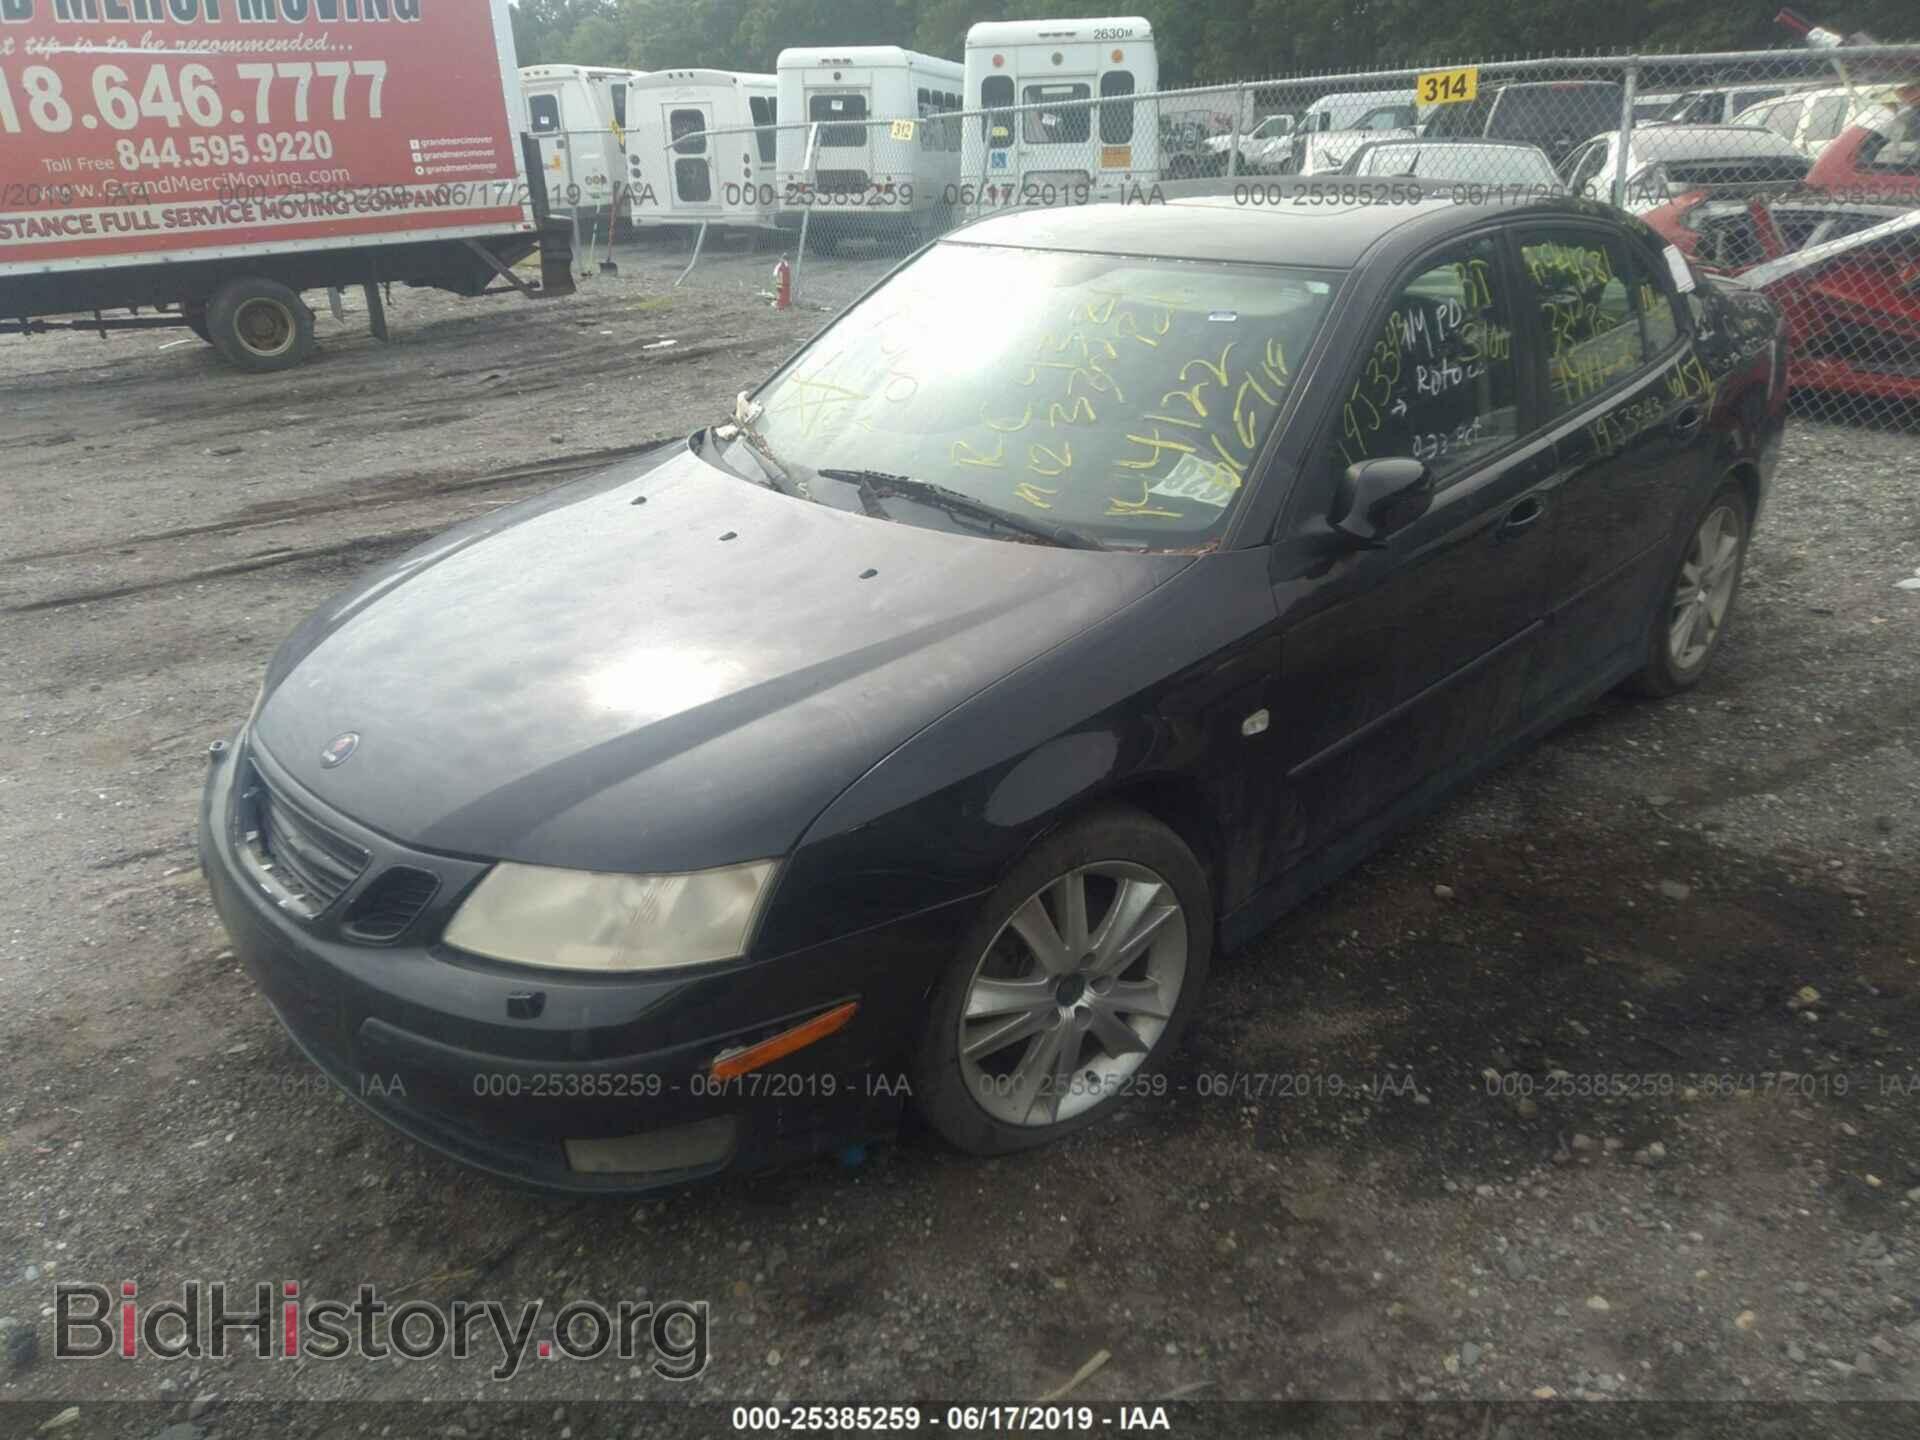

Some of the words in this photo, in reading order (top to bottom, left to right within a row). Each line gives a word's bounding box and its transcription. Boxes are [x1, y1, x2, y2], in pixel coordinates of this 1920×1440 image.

[1424, 73, 1468, 102] 314
[893, 121, 911, 138] 312
[40, 157, 72, 173] Toll
[77, 155, 115, 171] Free
[115, 129, 334, 171] 844.595.9220
[38, 167, 351, 201] www.GrandMerciMoving.com
[99, 211, 161, 233] FULL
[161, 203, 256, 229] SERVICE
[260, 195, 350, 220] MOVING
[353, 188, 449, 213] COMPANY
